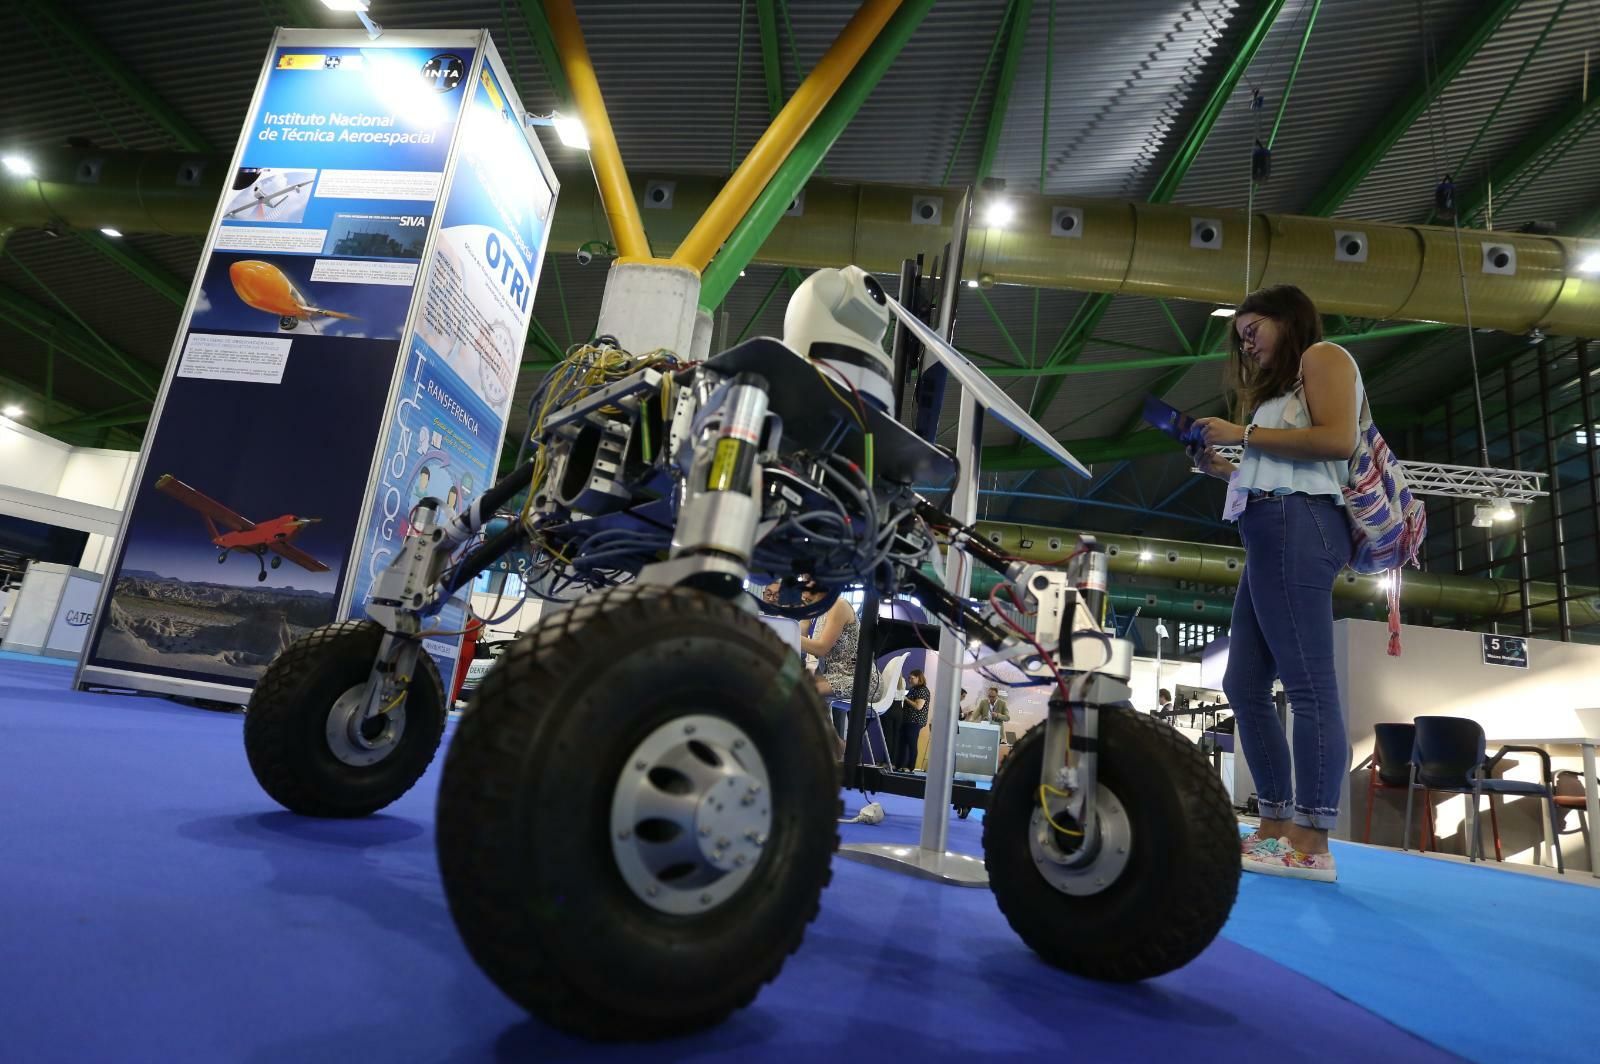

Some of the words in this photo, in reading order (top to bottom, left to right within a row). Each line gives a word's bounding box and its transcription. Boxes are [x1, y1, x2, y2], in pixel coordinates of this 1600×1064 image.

[425, 69, 459, 79] INTA
[263, 112, 326, 126] Instituto
[329, 112, 395, 127] Nacional
[258, 128, 277, 141] de
[281, 127, 338, 142] Técnica
[338, 129, 436, 146] Aeroespacial
[399, 215, 425, 227] SIVA
[486, 232, 531, 314] OTRI
[518, 558, 526, 572] 2
[66, 610, 93, 625] CATE
[1491, 638, 1500, 650] 5
[469, 666, 489, 675] DEKRA
